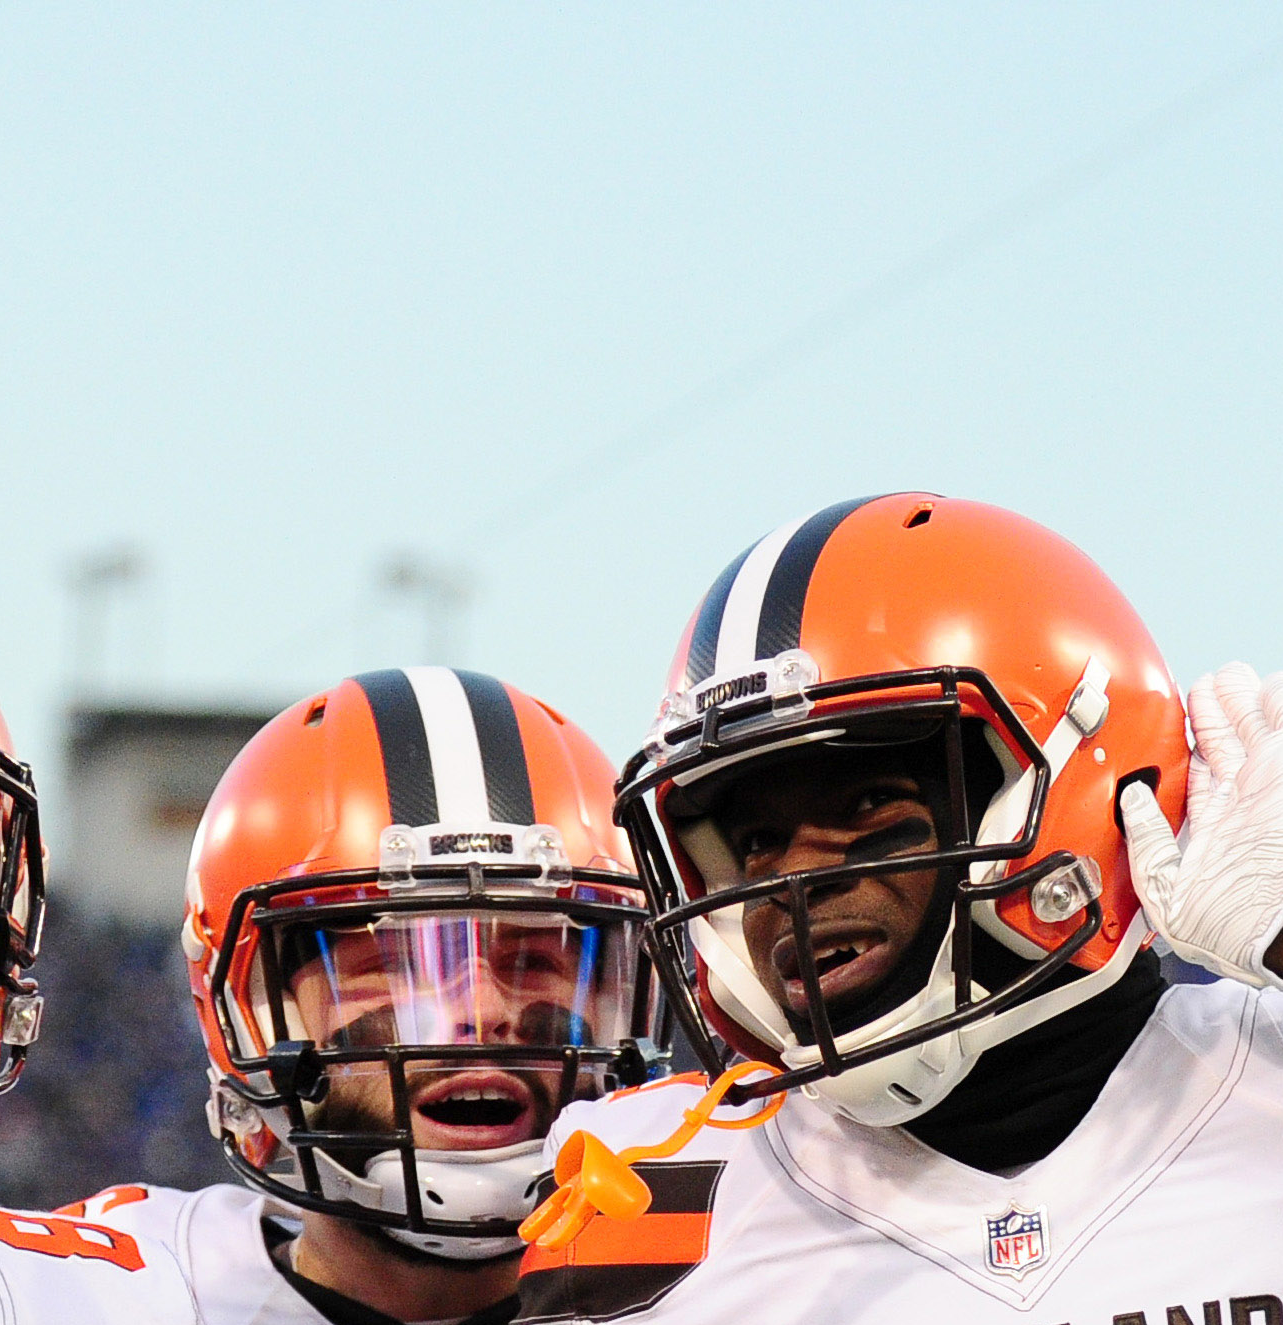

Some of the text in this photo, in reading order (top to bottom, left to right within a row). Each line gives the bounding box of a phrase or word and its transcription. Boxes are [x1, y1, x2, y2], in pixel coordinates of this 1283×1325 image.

[696, 671, 768, 714] BROWNS
[429, 833, 513, 855] BROWNS
[994, 1234, 1039, 1265] NFL
